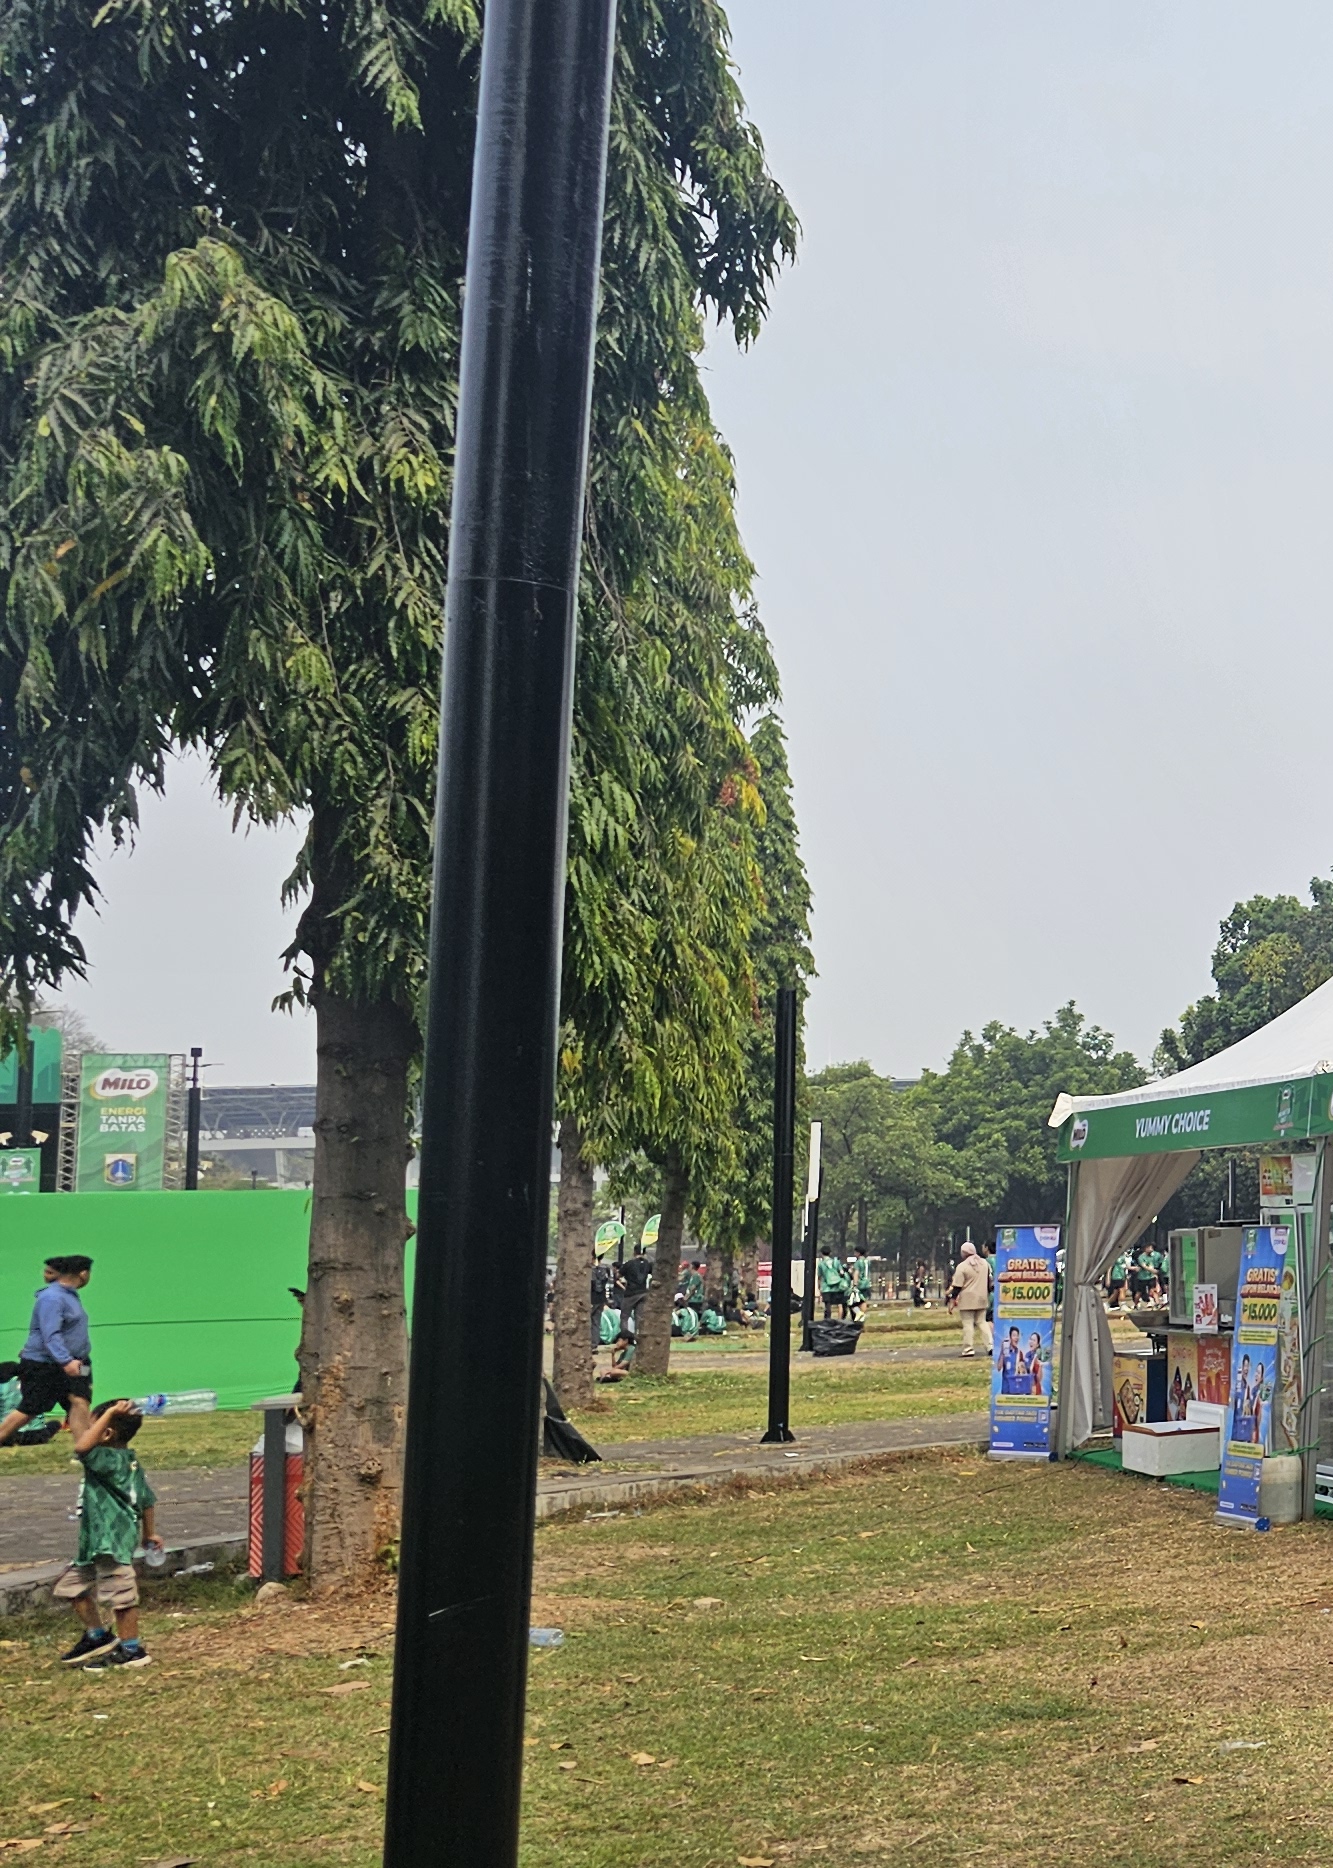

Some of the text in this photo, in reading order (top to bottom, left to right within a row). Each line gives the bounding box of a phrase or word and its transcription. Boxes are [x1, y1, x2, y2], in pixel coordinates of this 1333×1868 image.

[101, 1077, 151, 1091] MILO
[100, 1107, 147, 1116] ENERGI
[100, 1116, 146, 1124] TANPA
[1135, 1109, 1211, 1138] YUMMY CHOICE
[100, 1124, 146, 1133] BATAS
[1012, 1286, 1051, 1300] 15.000
[1248, 1303, 1277, 1321] 15.000
